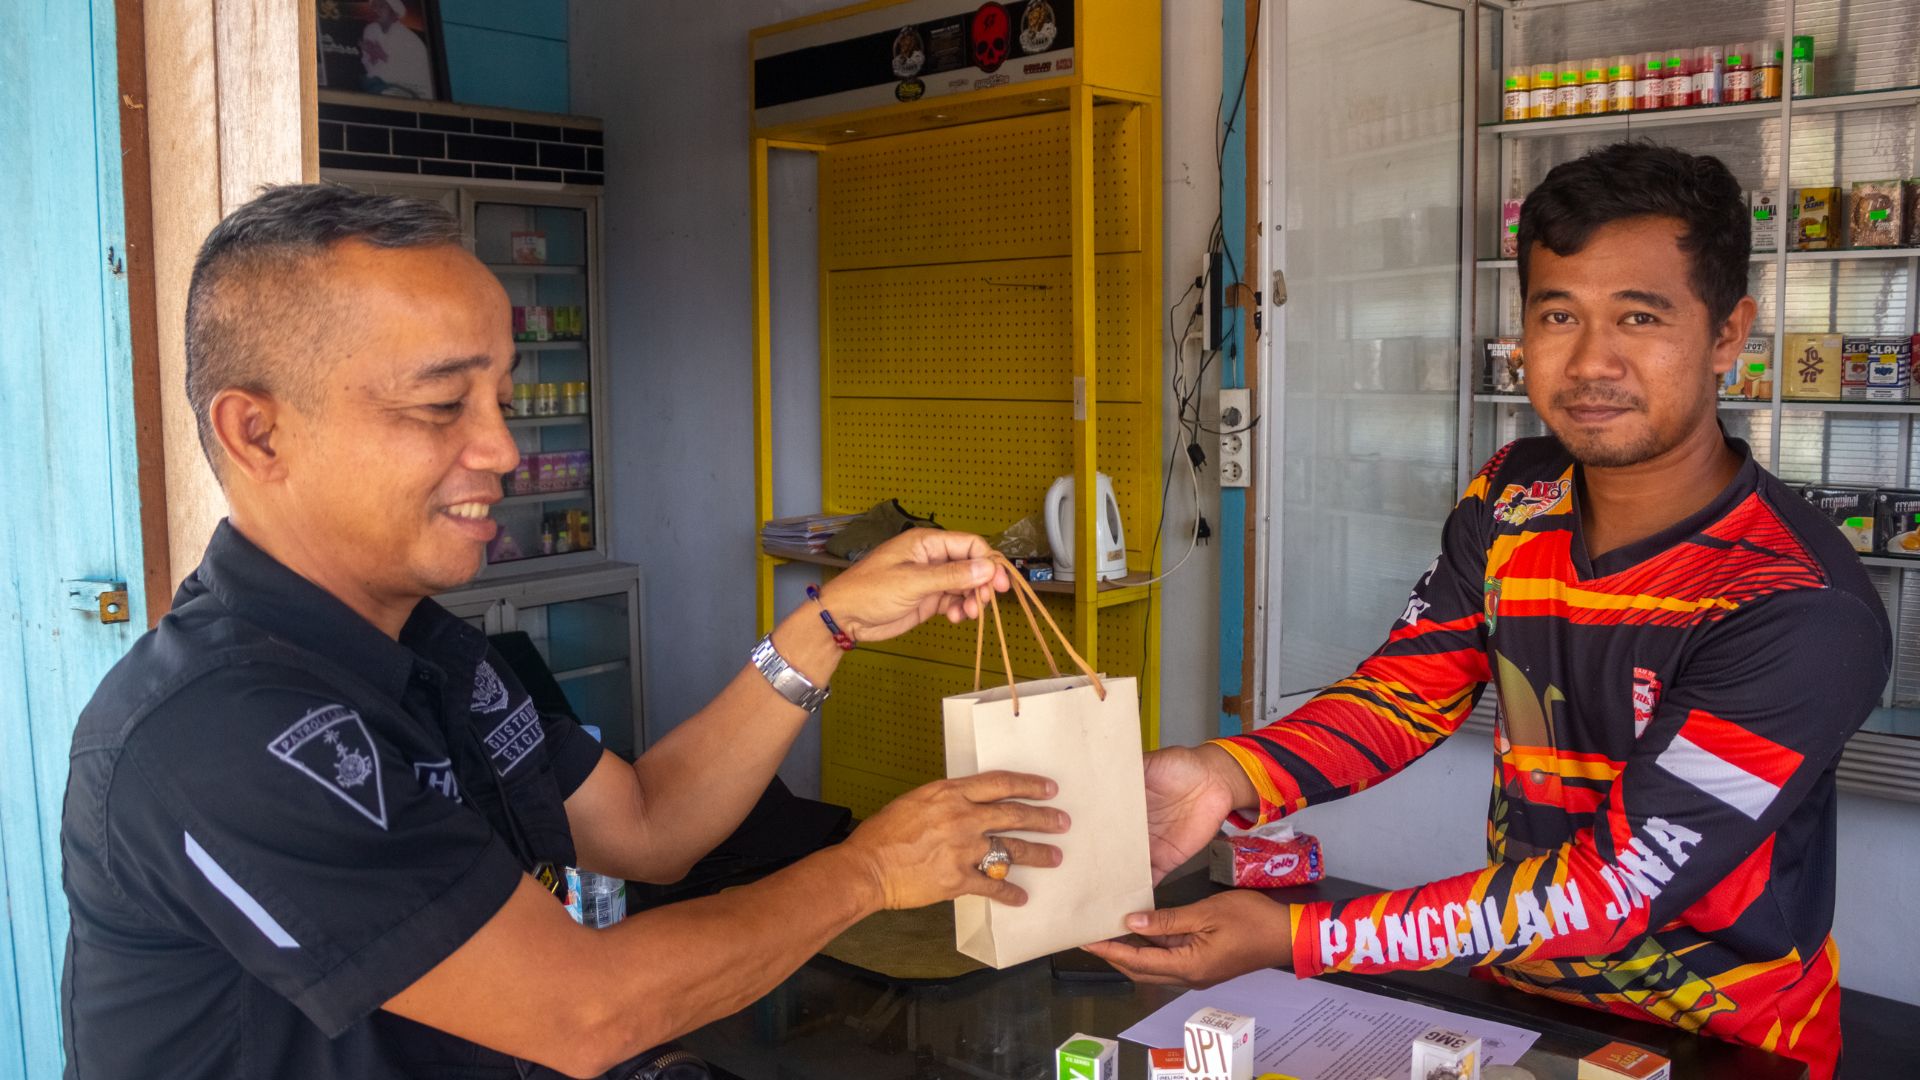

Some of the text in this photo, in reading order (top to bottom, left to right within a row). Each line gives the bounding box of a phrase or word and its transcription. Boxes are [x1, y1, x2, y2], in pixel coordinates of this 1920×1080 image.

[1870, 345, 1900, 354] SLAY
[1269, 858, 1295, 874] jolly
[1319, 877, 1589, 967] PANGGILAN
[1423, 1031, 1467, 1048] 3MG
